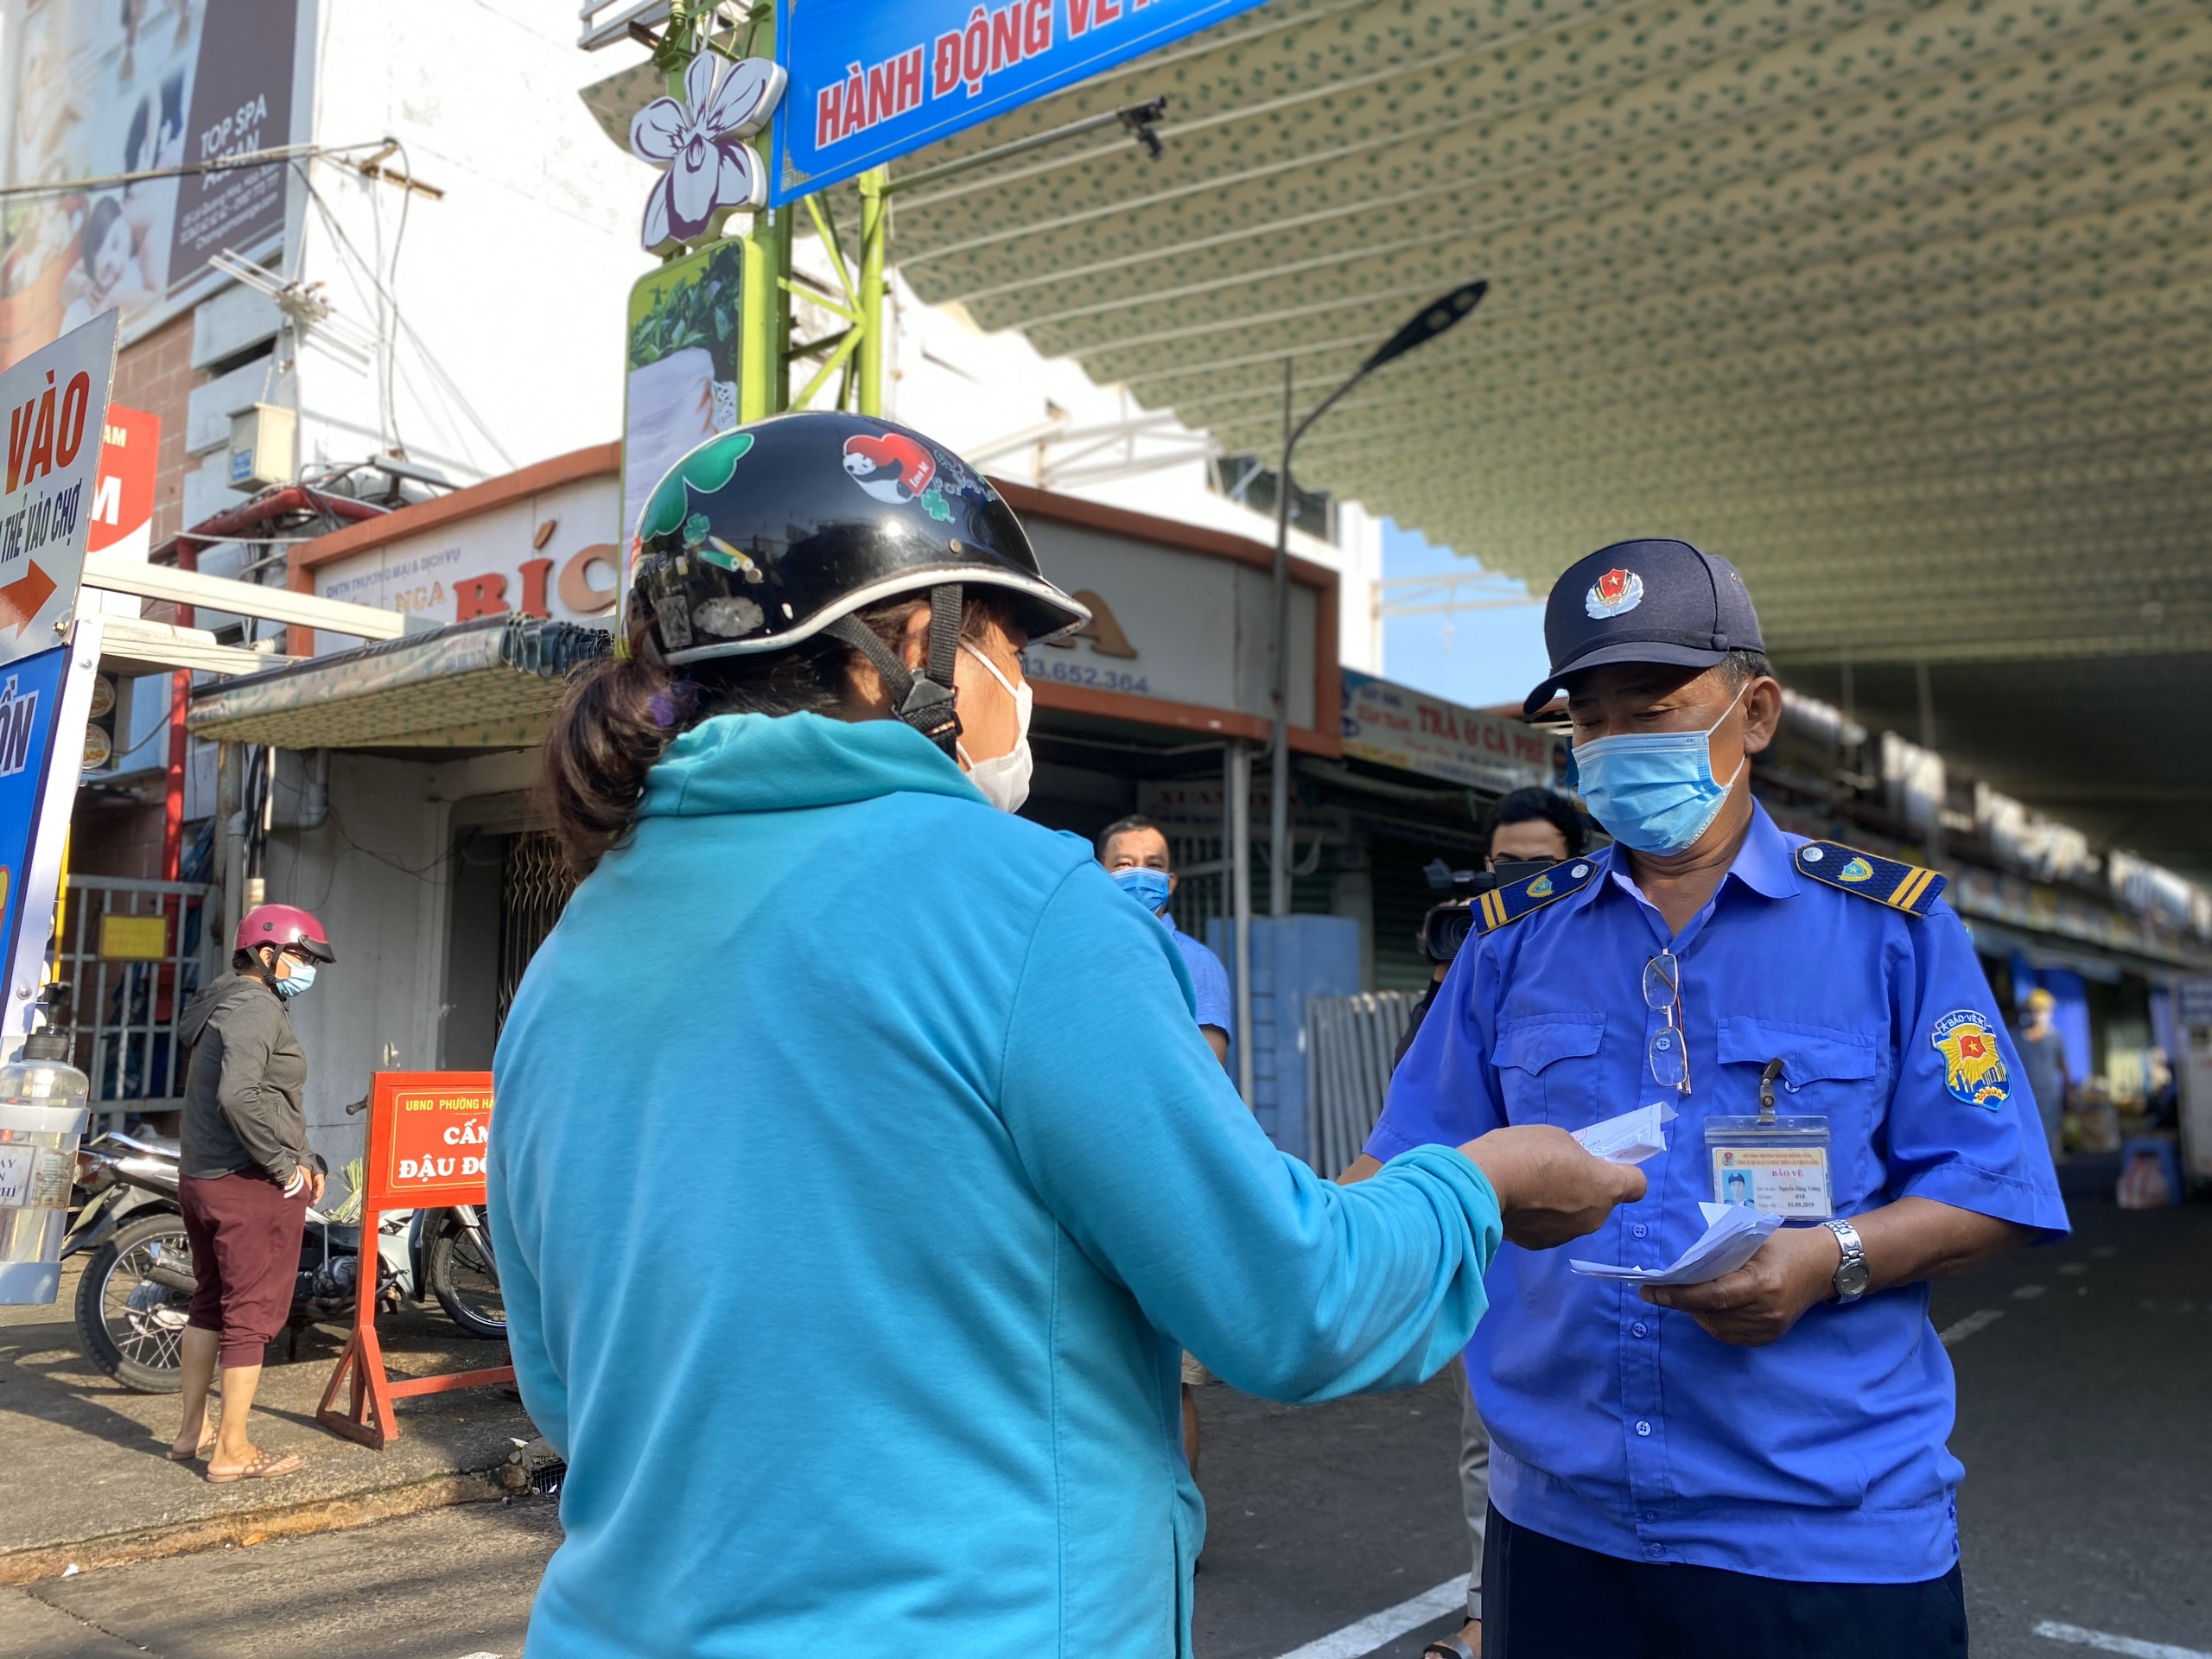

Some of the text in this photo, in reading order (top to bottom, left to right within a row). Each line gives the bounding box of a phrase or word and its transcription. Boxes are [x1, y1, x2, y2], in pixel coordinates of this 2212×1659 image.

[815, 43, 924, 151] HÀNH
[931, 0, 1052, 99] ĐỘNG
[200, 93, 267, 160] TOP SPA
[5, 368, 90, 495] VÀO
[1, 477, 83, 563] THẺ VÀO CHỢ
[394, 581, 446, 613] NGA
[1948, 1013, 1965, 1027] BẢO
[405, 1100, 434, 1111] UBND
[439, 1097, 479, 1110] PHƯỜNG
[398, 1154, 455, 1182] ĐẬU
[1771, 1168, 1803, 1178] BẢO VỆ
